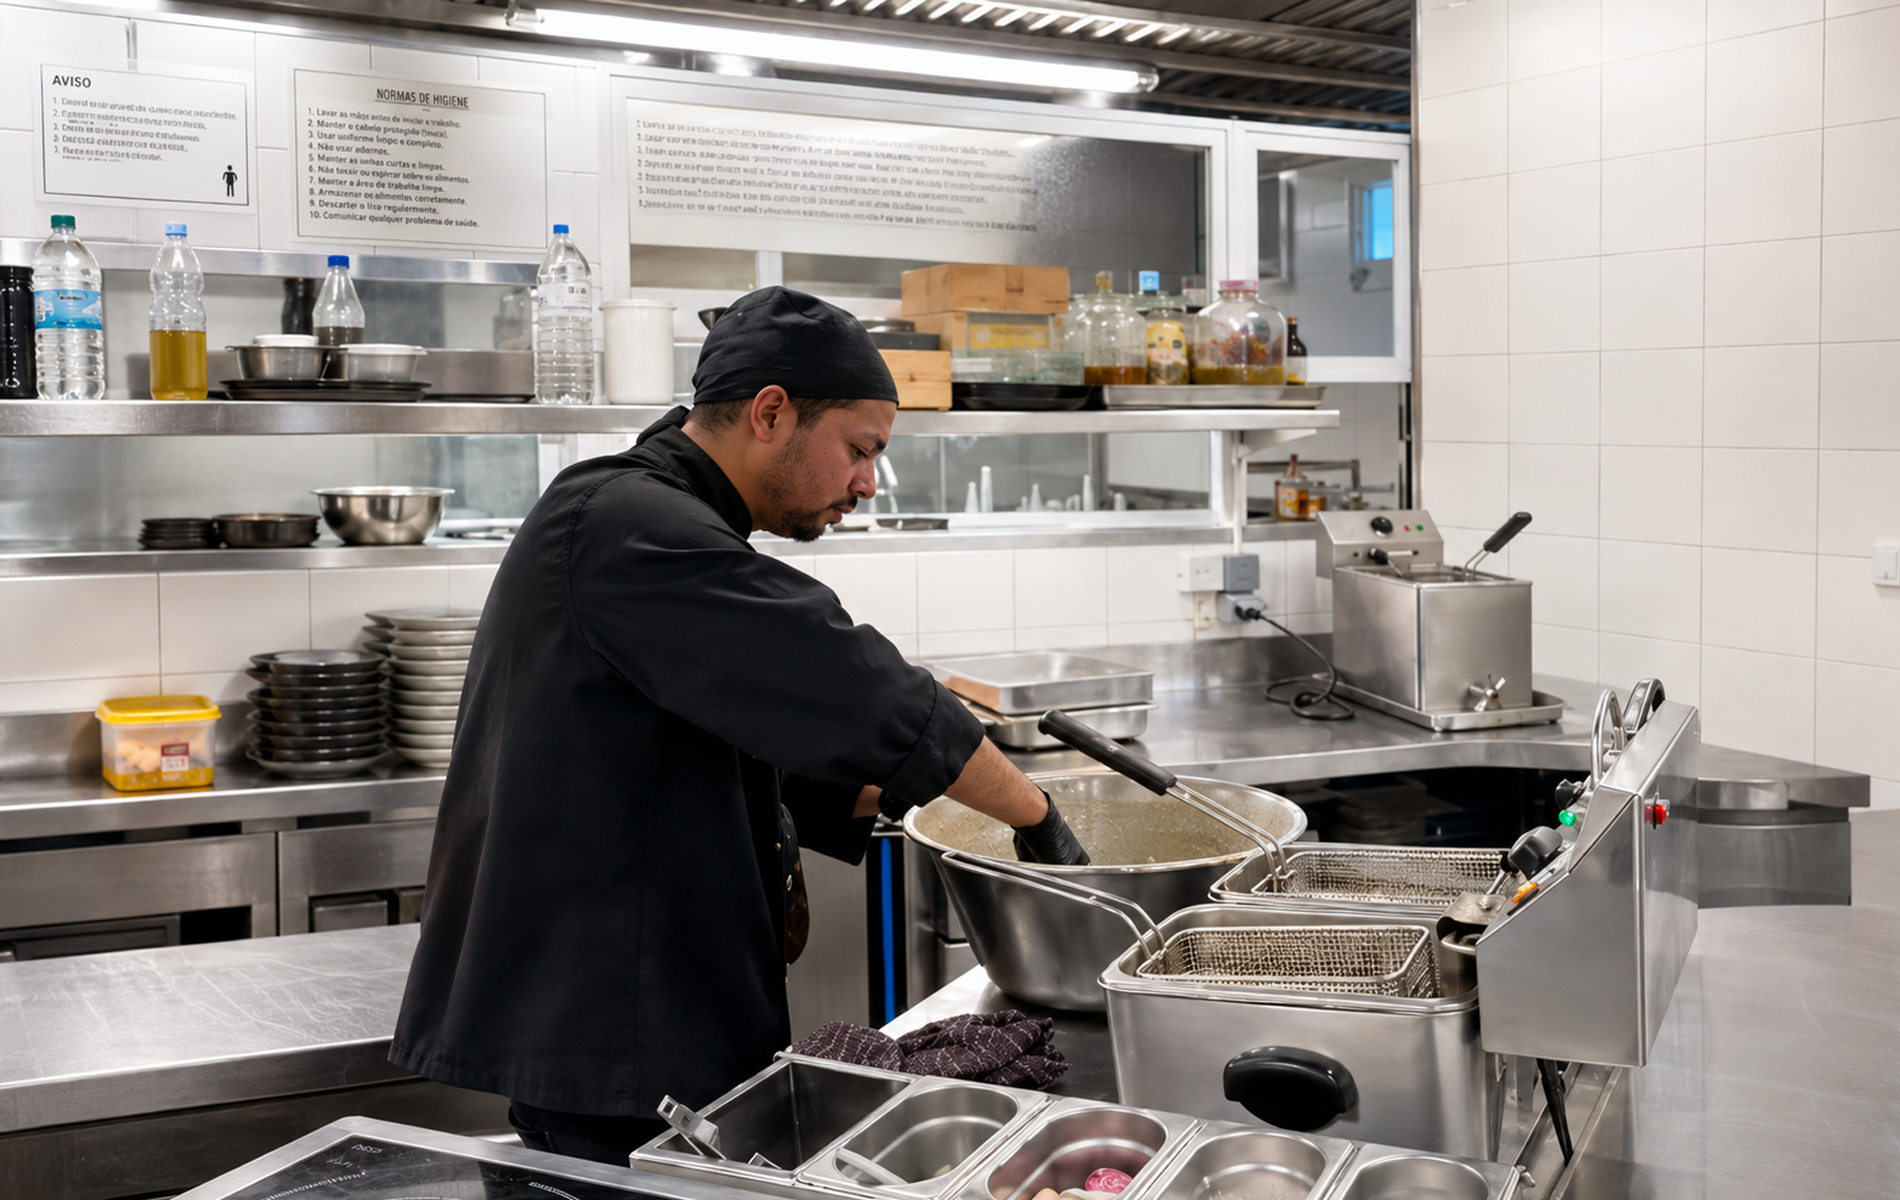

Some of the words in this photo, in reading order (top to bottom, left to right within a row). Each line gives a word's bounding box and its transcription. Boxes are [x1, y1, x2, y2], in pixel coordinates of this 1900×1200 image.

[52, 74, 92, 88] AVISO
[376, 88, 416, 102] NORMAS
[419, 92, 430, 104] DE
[433, 94, 469, 108] HIGIENE
[386, 160, 410, 168] curtas
[405, 216, 442, 226] problema
[444, 218, 453, 226] de
